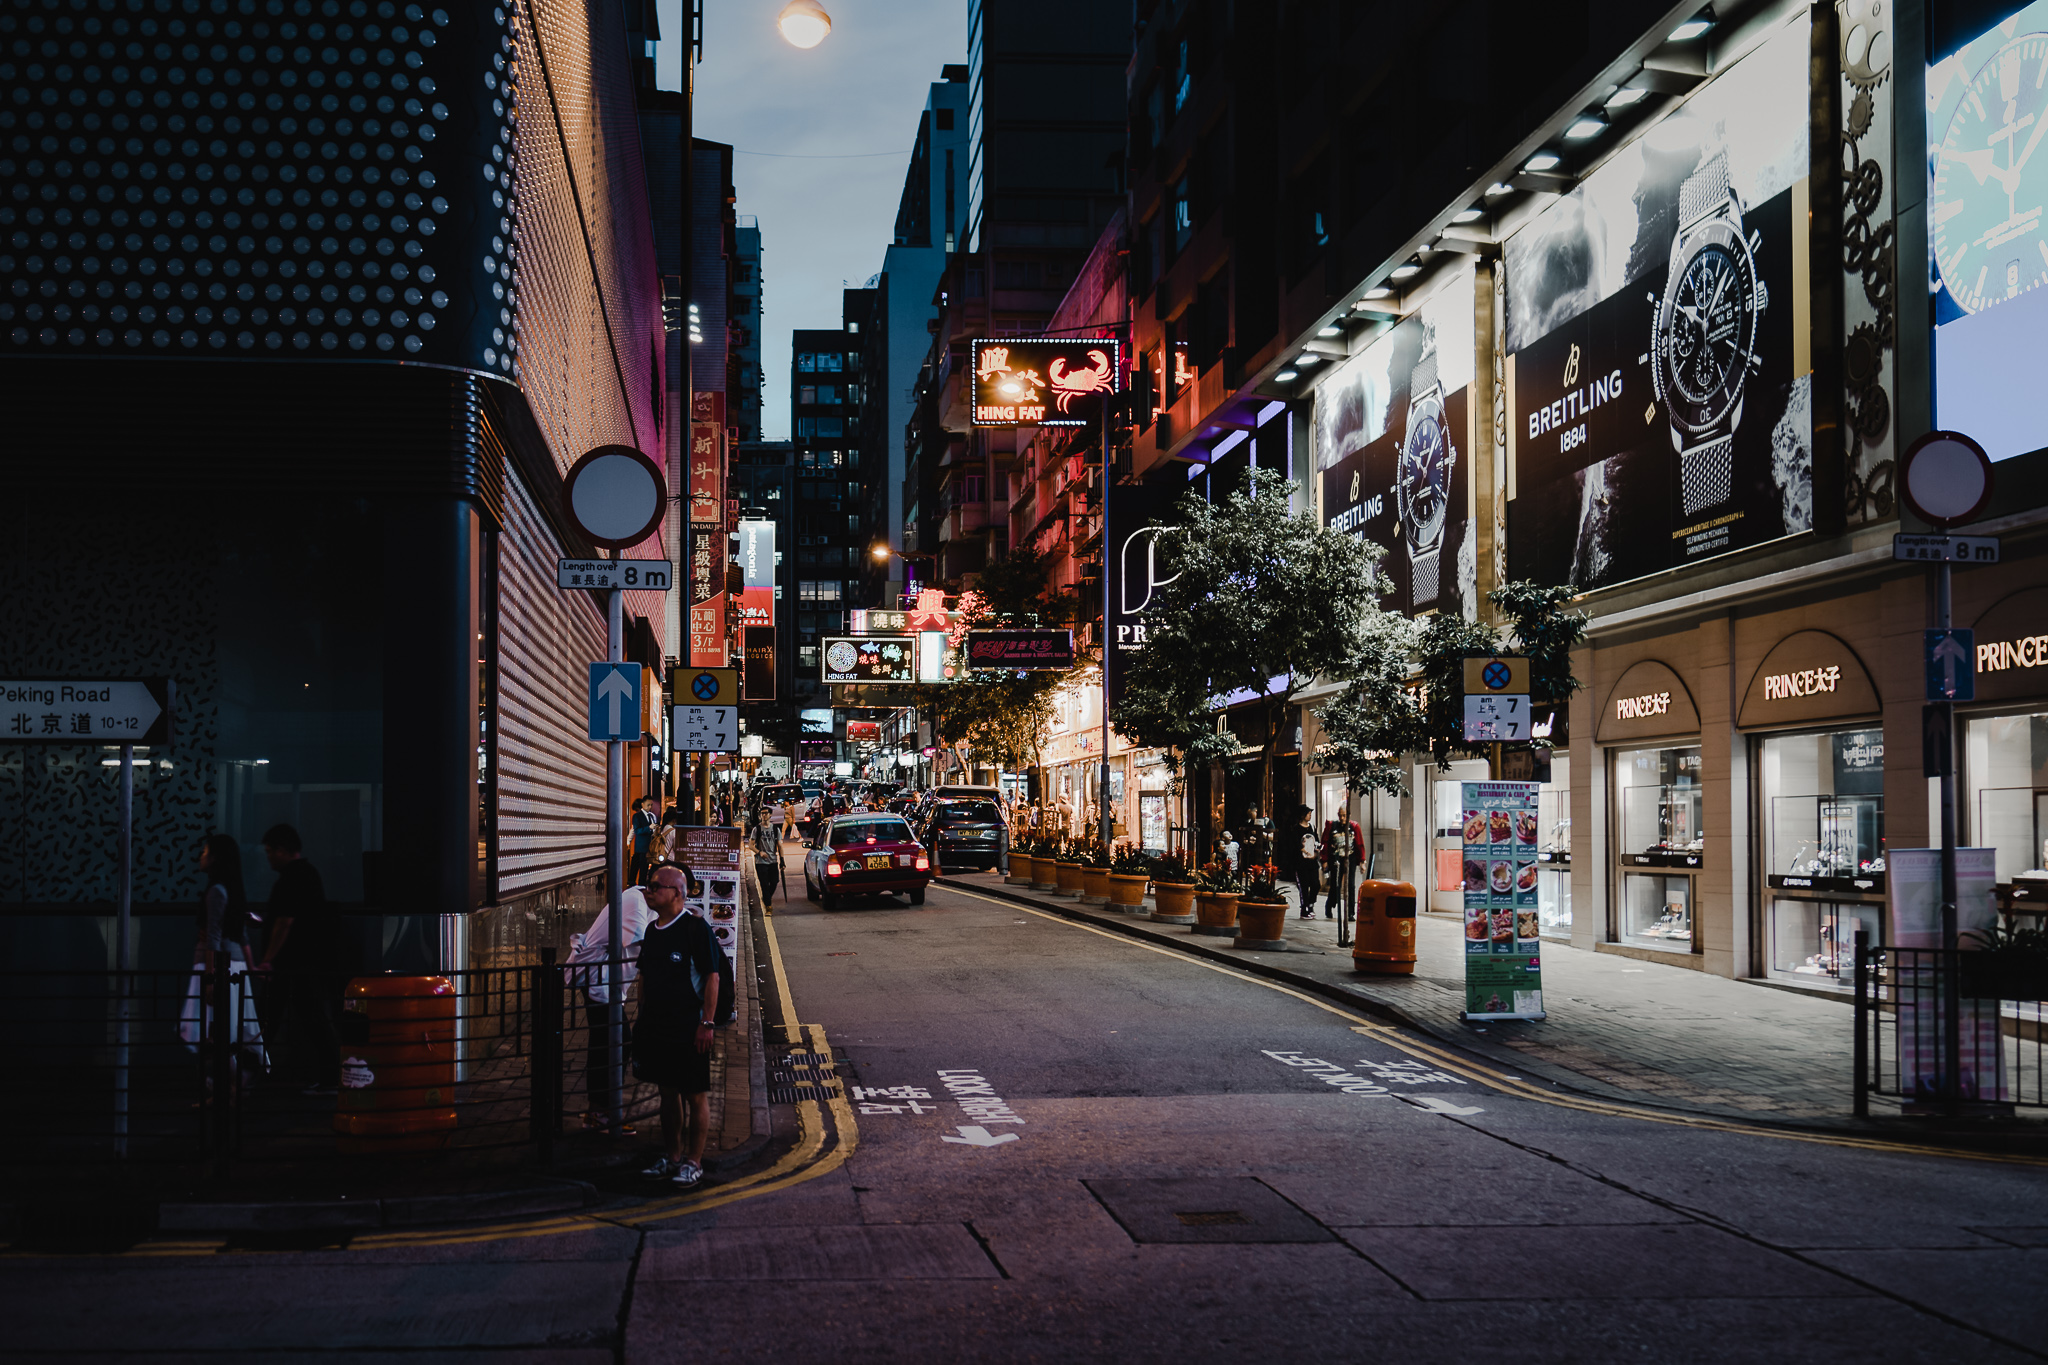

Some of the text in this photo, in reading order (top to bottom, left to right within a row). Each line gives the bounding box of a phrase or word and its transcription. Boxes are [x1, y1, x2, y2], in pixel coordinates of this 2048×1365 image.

[977, 406, 1045, 420] HING FAT
[1528, 369, 1623, 440] BREITLING
[1560, 423, 1587, 454] 1884
[693, 436, 713, 507] 新斗記
[1330, 494, 1383, 534] BREITLING
[1672, 527, 1694, 540] SUPEROCEAN
[1693, 522, 1710, 534] HERITAGE
[1712, 512, 1740, 528] CHRONOGRAPH
[1685, 526, 1729, 546] SELFWINDING MECHANICAL
[1898, 536, 1950, 546] Length over
[747, 526, 758, 579] patagonia
[1956, 542, 1995, 560] 8 m
[563, 562, 618, 572] Length over
[571, 574, 609, 586] 車長逾
[624, 567, 666, 586] 8 m
[692, 610, 714, 622] 九龍
[911, 588, 949, 626] 興
[692, 621, 714, 632] 中心
[873, 612, 906, 629] 燒味
[693, 634, 714, 648] 3/F
[971, 640, 1008, 659] OCEAN
[1976, 635, 2048, 673] PRINCE
[1764, 671, 1815, 700] PRINCE
[1813, 665, 1841, 693] 太子
[61, 686, 110, 702] Road
[1651, 691, 1671, 715] 太子
[1477, 705, 1497, 713] 上午
[1506, 698, 1518, 713] 7
[1616, 695, 1653, 720] PRINCE
[11, 713, 92, 734] 北京道
[101, 717, 139, 730] 10-12
[686, 716, 705, 724] 上午
[715, 710, 726, 724] 7
[1507, 722, 1518, 737] 7
[686, 740, 705, 748] 下午
[715, 734, 726, 748] 7
[1261, 1050, 1406, 1099] LOOK LEFT
[936, 1069, 1026, 1124] LOOK RIGHT
